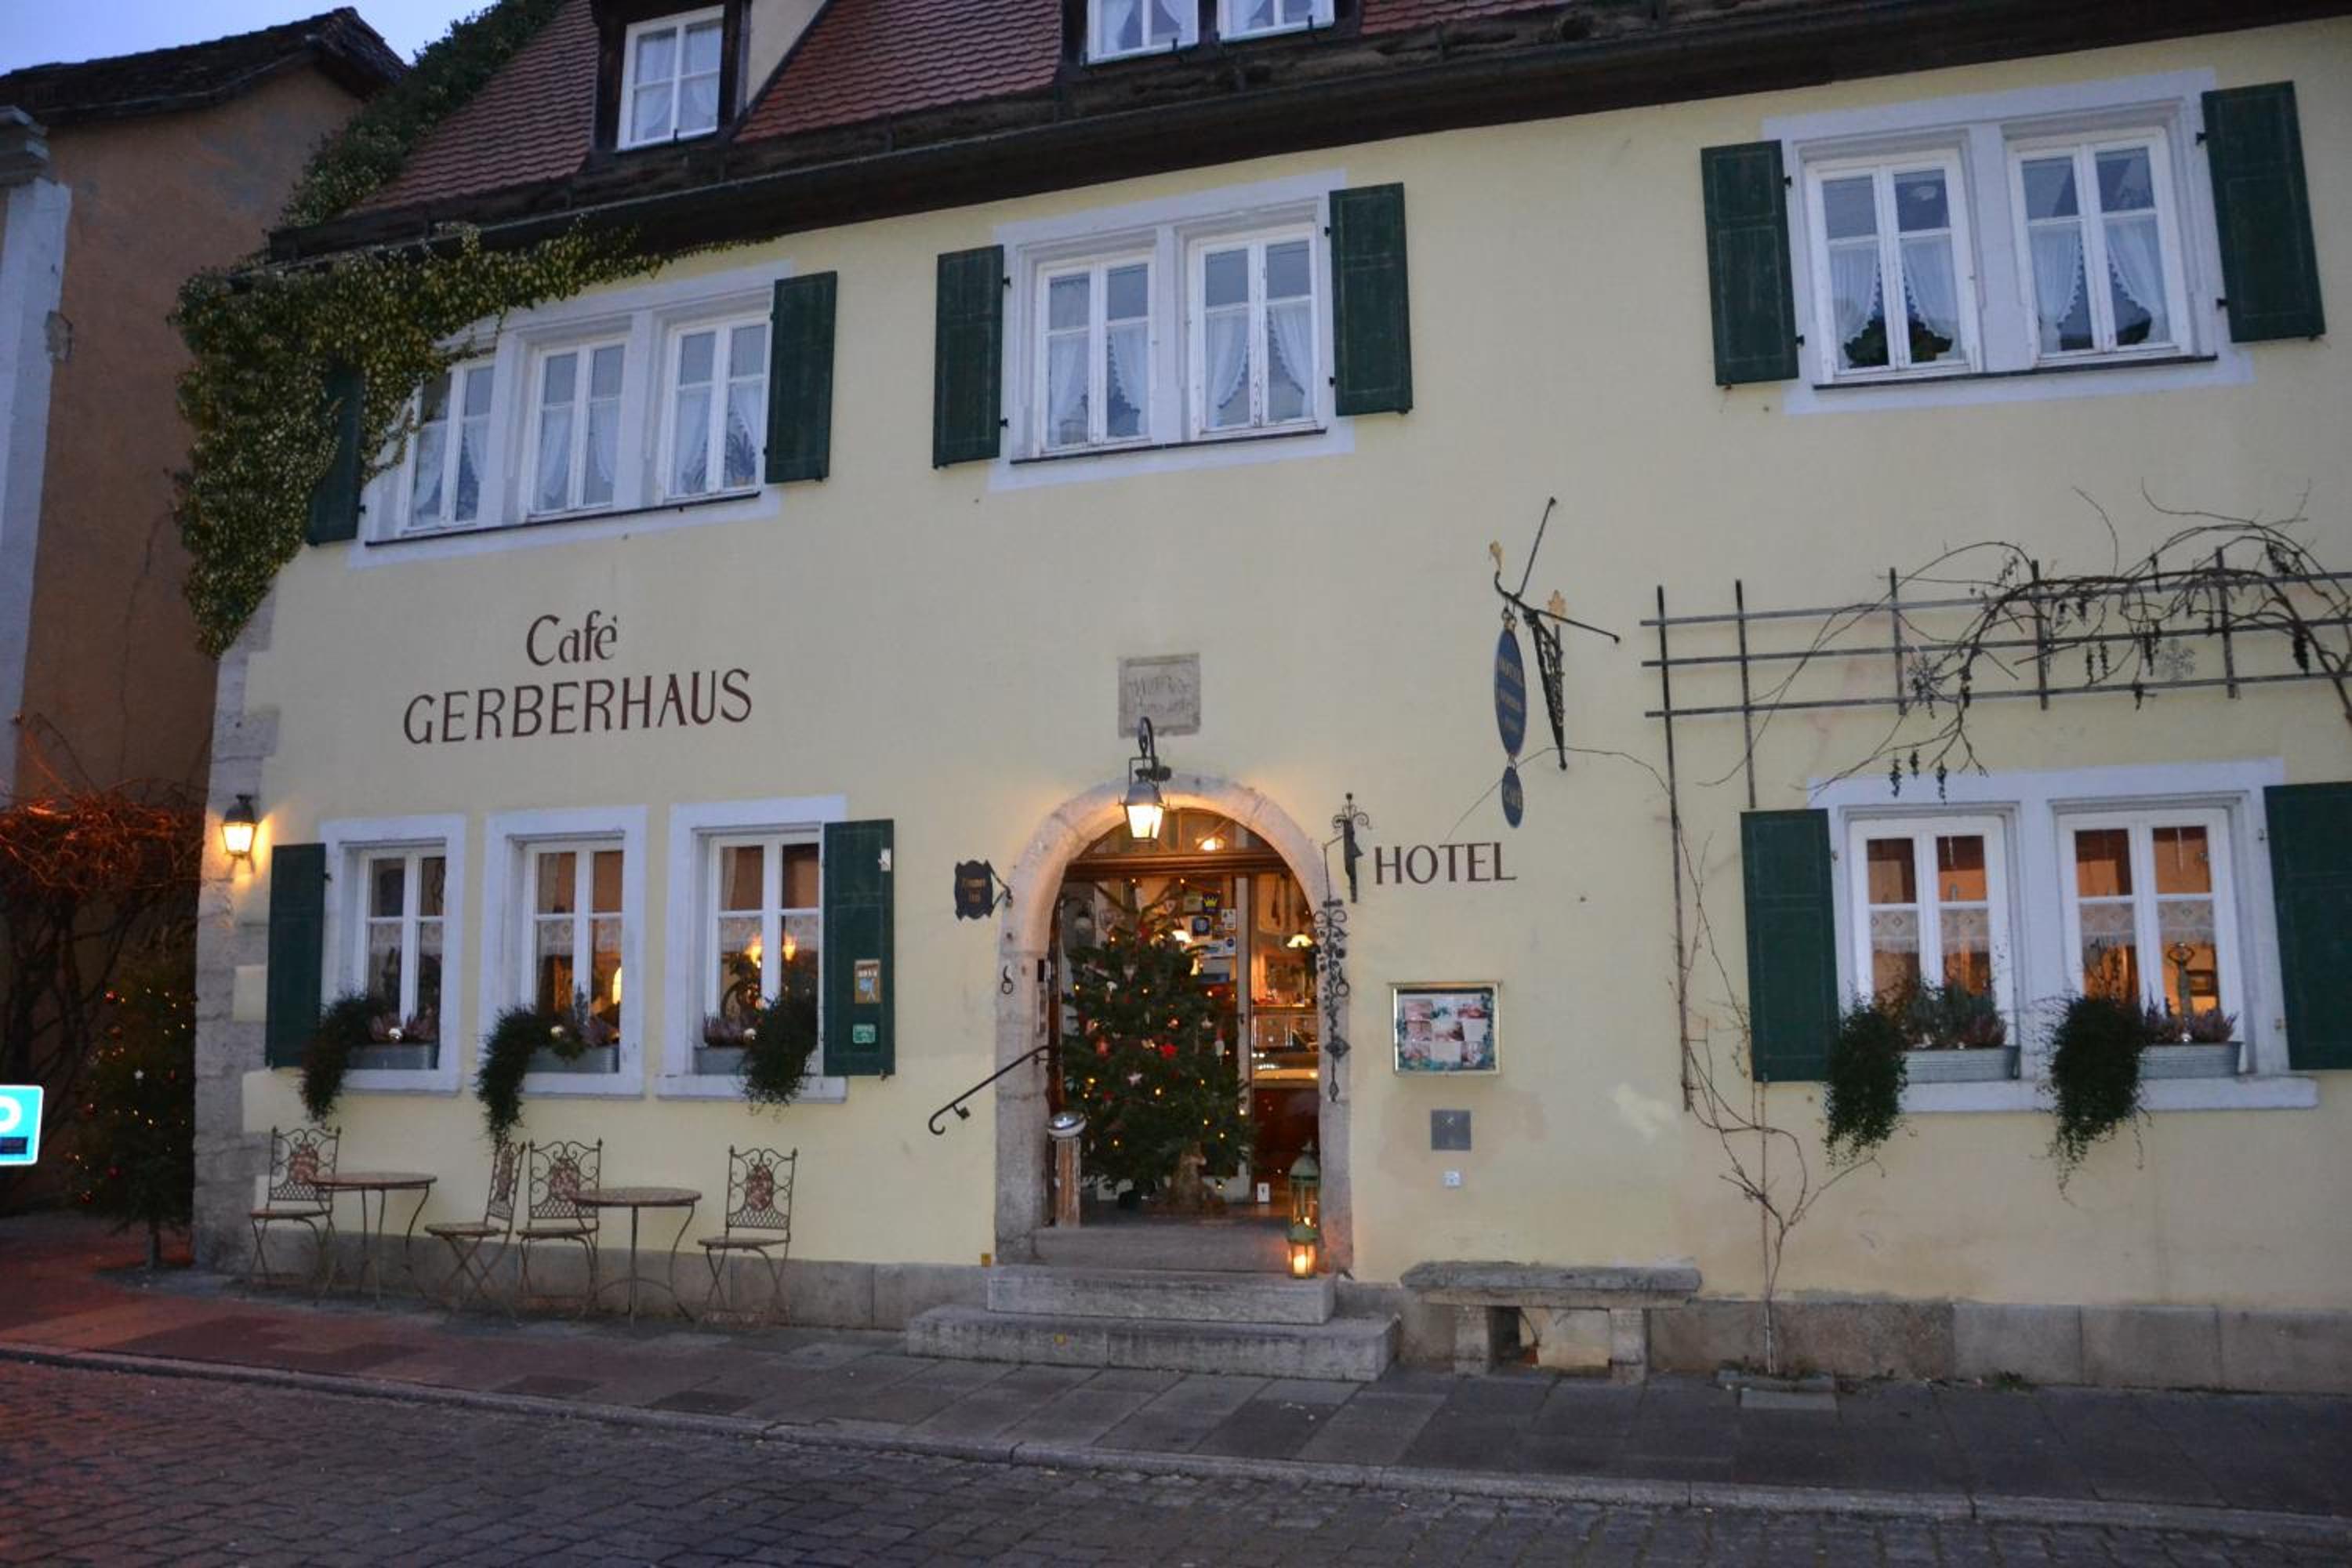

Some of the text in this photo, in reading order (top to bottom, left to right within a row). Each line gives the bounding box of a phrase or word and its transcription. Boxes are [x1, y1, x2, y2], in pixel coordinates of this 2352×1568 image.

[525, 609, 618, 667] Café
[402, 667, 753, 745] GERBERHAUS
[1374, 841, 1518, 885] HOTEL
